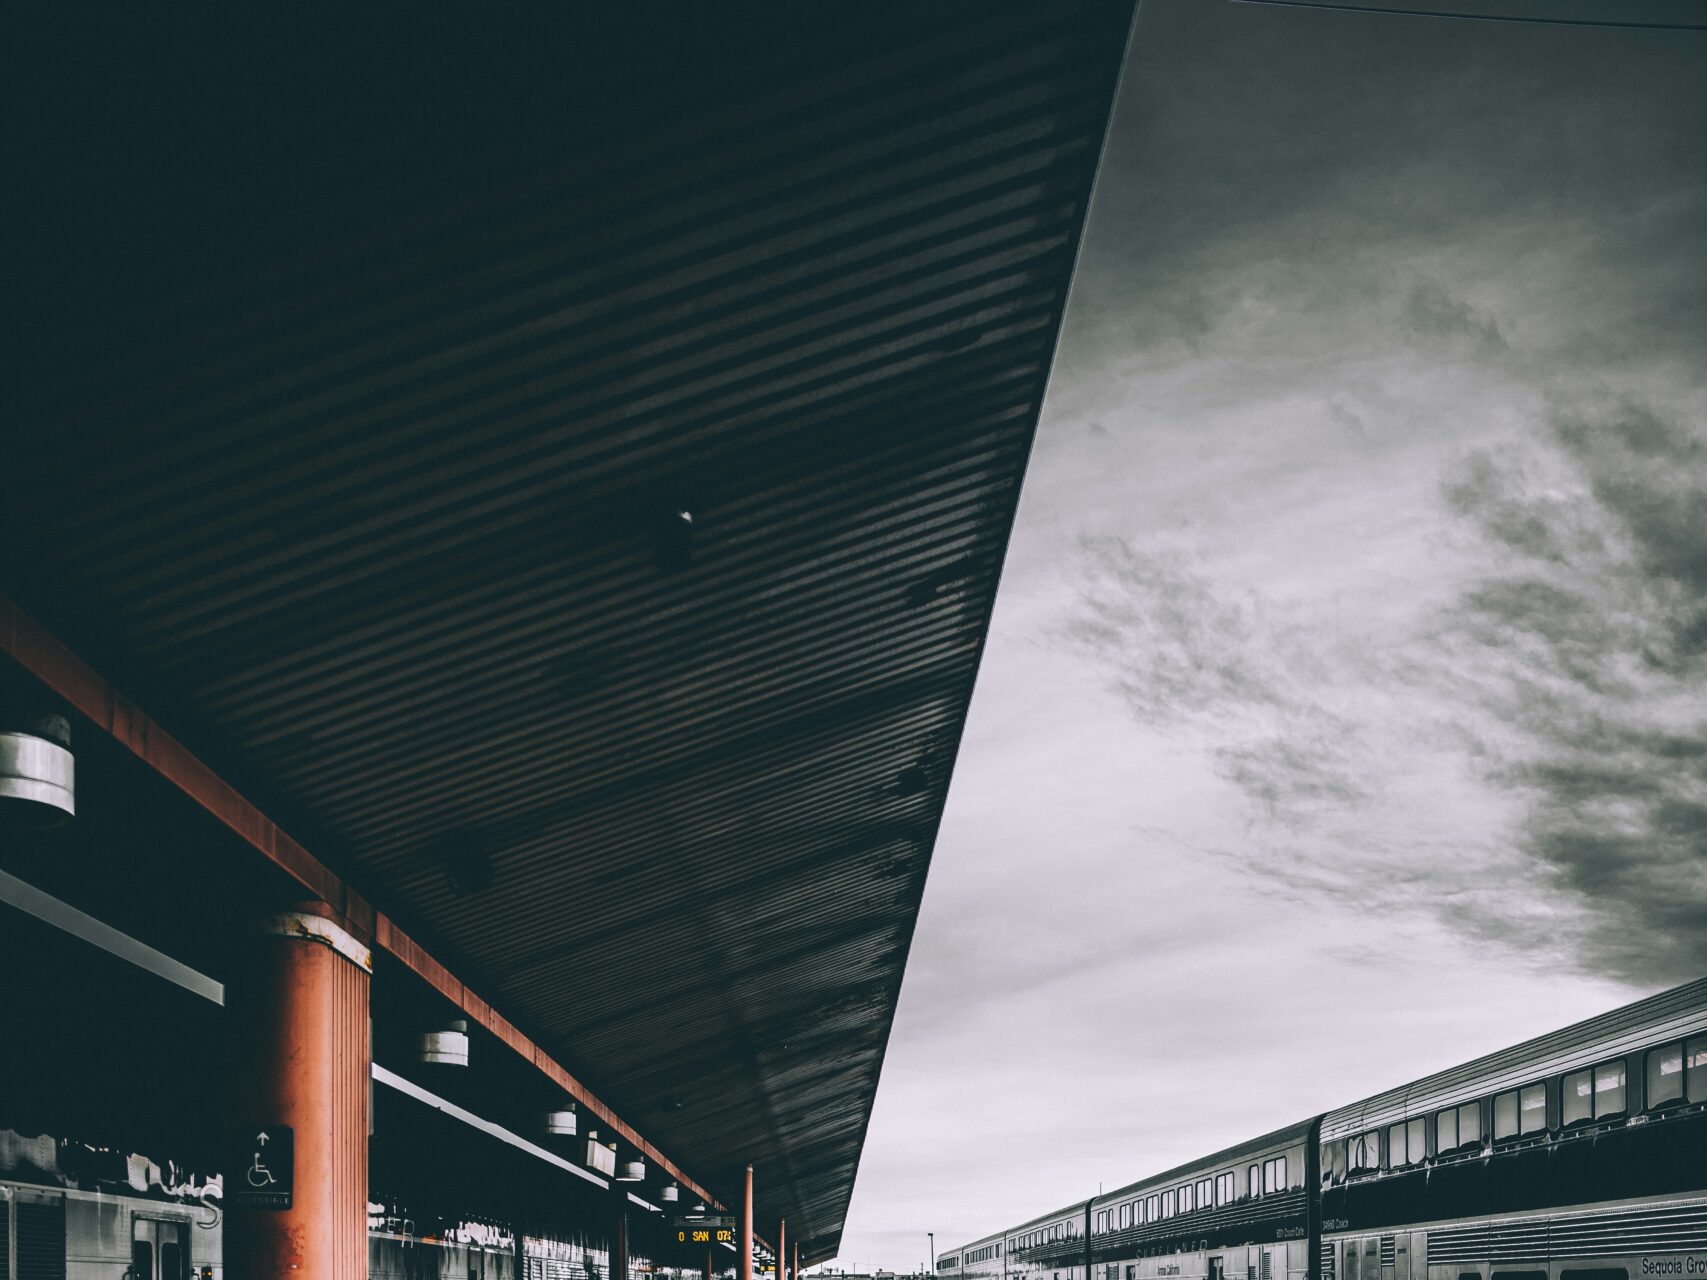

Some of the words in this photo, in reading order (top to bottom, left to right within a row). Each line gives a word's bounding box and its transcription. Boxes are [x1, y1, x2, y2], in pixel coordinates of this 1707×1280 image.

[692, 1231, 709, 1241] SAN
[1642, 1257, 1682, 1278] Sequoia
[1686, 1256, 1707, 1274] Gro
